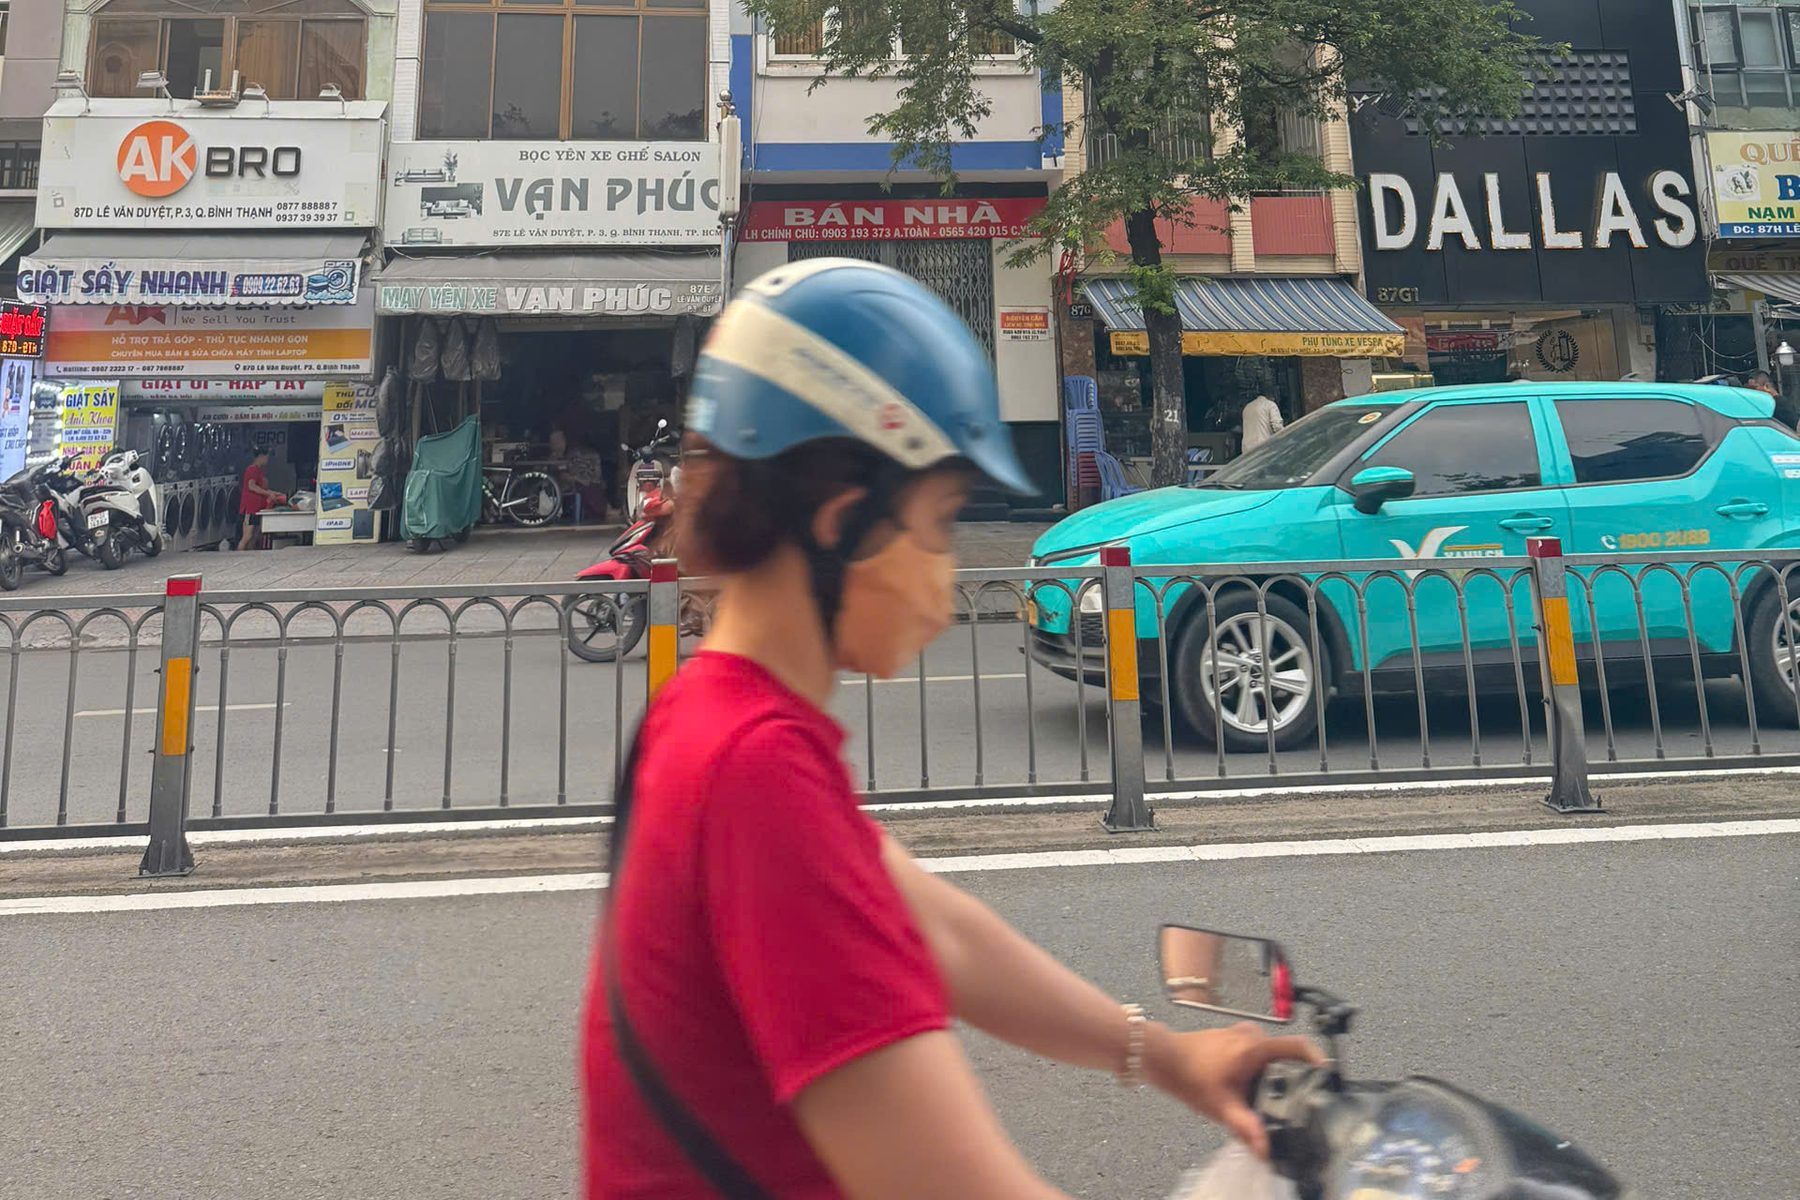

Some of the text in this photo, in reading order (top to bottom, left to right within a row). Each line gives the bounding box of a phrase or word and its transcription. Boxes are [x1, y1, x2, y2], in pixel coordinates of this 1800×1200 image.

[120, 136, 301, 181] AK BRO
[519, 146, 700, 163] BỌC YÊN XE GHẾ SALON
[495, 170, 719, 220] VẠN PHÚC
[74, 207, 93, 218] 87D
[97, 205, 110, 218] LÊ
[113, 205, 133, 218] VĂN
[136, 205, 173, 219] DUYỆT,
[236, 207, 272, 219] THẠNH
[277, 202, 299, 210] 0877
[1369, 170, 1696, 250] DALLAS
[275, 214, 338, 222] 0937 39 39 37
[784, 201, 1002, 226] BÁN NHÀ
[1748, 207, 1795, 221] NẠM
[493, 229, 511, 237] 87E
[514, 228, 526, 237] LÊ
[745, 230, 758, 239] LH
[761, 227, 791, 239] CHÍNH
[795, 225, 819, 239] CHỦ:
[822, 228, 847, 238] 0903
[851, 228, 869, 238] 193
[872, 228, 891, 238] 373
[894, 225, 930, 238] A.TOÀN
[939, 226, 964, 237] 0565
[968, 226, 986, 237] 420
[989, 226, 1008, 236] 015
[1758, 225, 1782, 233] 87H
[17, 261, 300, 299] GIẶT SẤY NHANH 0909.22.62.63
[382, 283, 672, 313] MAY YÊN XE VẠN PHÚC
[1377, 287, 1419, 302] 87G1
[1071, 305, 1091, 316] 87G
[182, 315, 296, 324] We Sell You Trust
[249, 335, 284, 344] NHANH
[1302, 335, 1383, 347] PHỤ TÙNG XE VESPA
[93, 388, 115, 407] SẤY
[1164, 409, 1180, 423] 21
